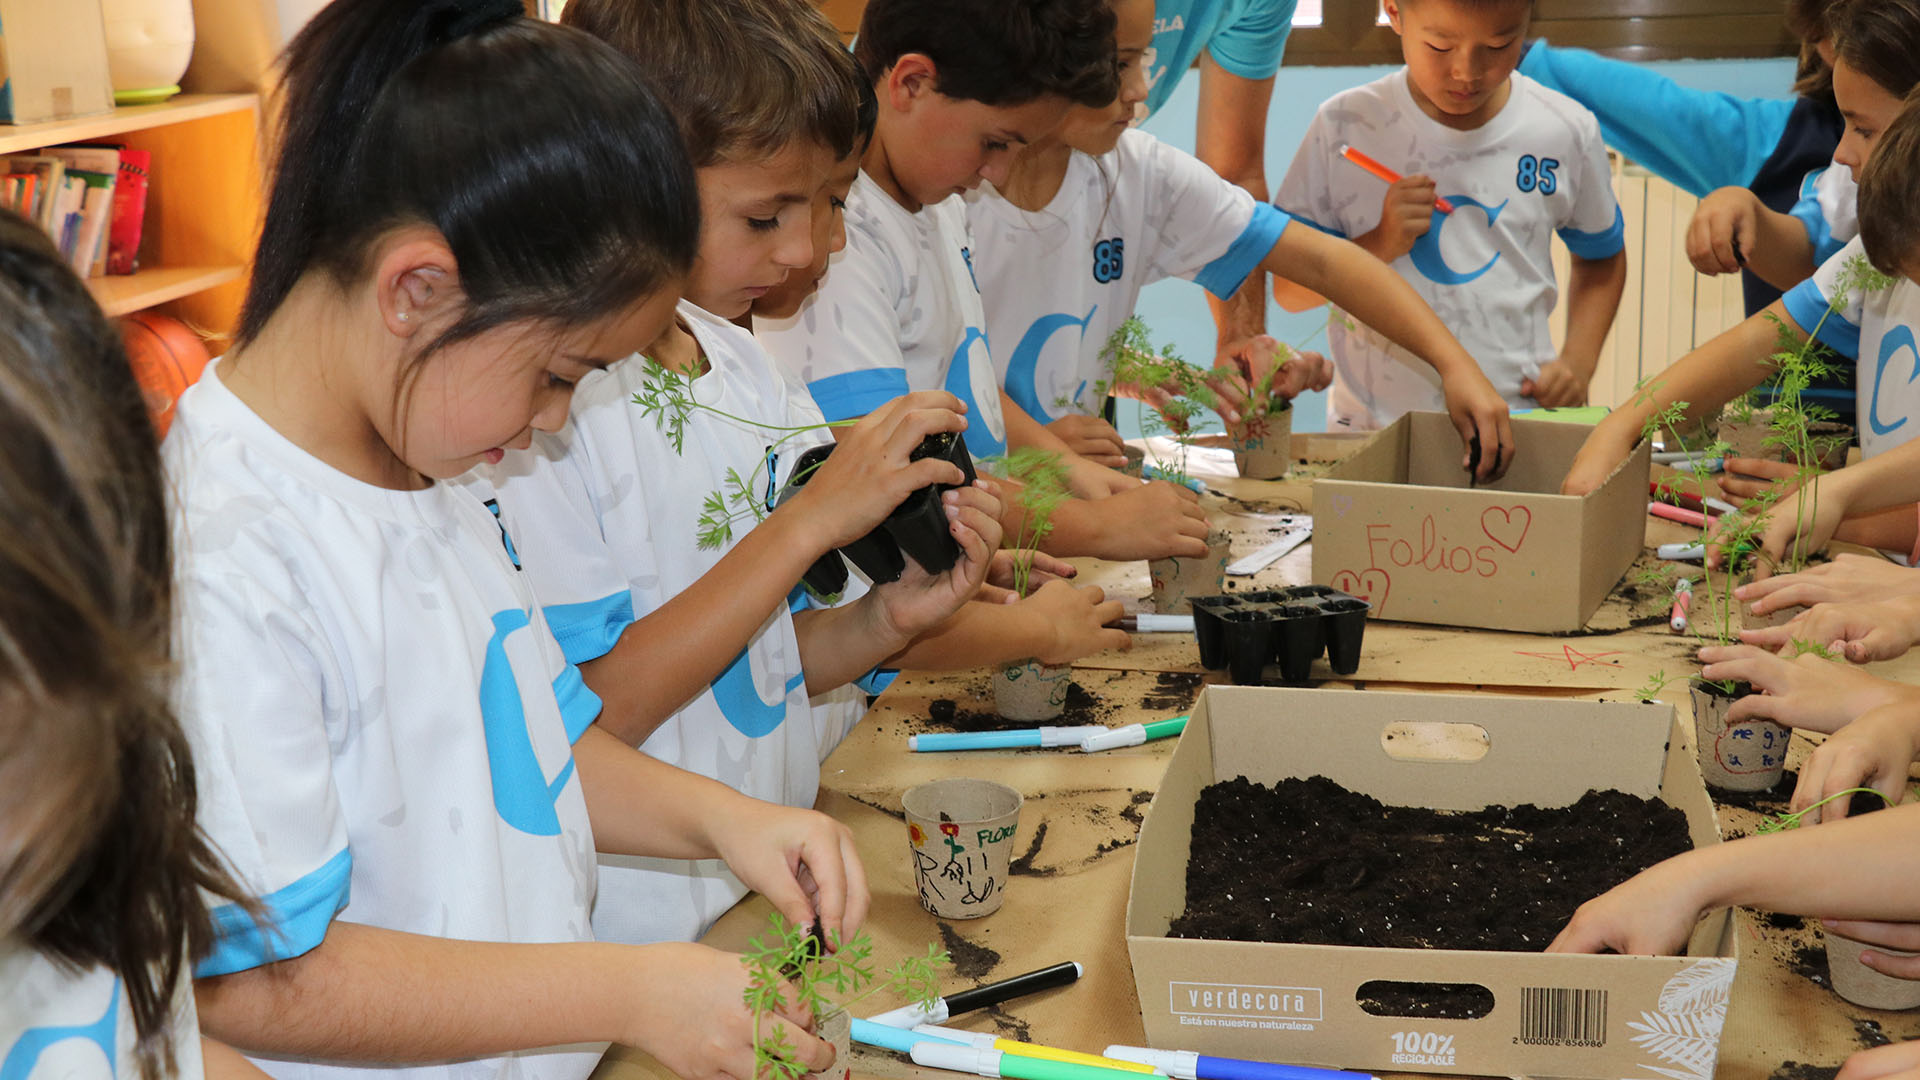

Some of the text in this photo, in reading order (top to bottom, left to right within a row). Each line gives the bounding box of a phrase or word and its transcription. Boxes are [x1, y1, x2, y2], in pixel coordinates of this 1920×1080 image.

[1516, 154, 1560, 196] 85
[1408, 194, 1510, 286] C
[1092, 237, 1124, 284] 85
[1366, 513, 1498, 578] Folios
[1188, 988, 1305, 1012] verdecora
[1179, 1015, 1314, 1031] Está en nuestra naturaleza
[1391, 1031, 1456, 1056] 100%
[1512, 1037, 1603, 1048] 2 000002 856986
[1391, 1053, 1456, 1066] RECICLABLE
